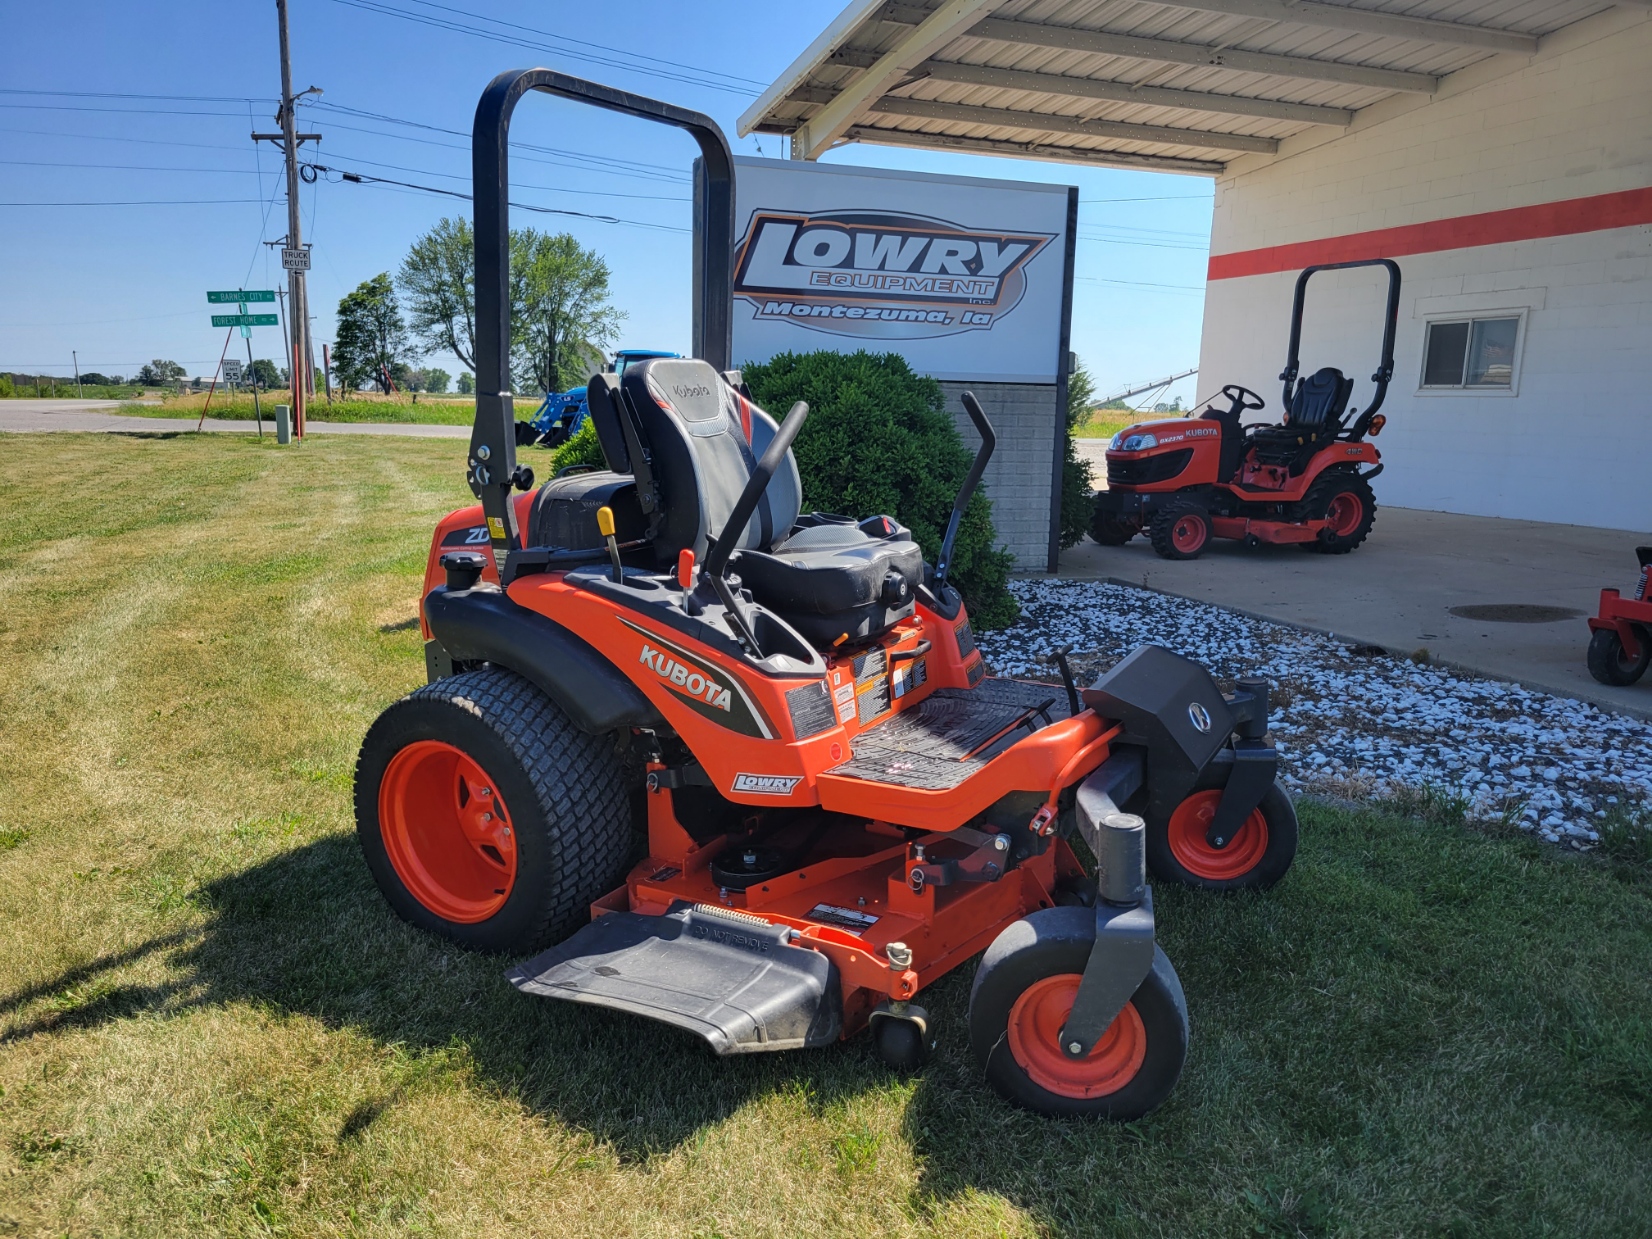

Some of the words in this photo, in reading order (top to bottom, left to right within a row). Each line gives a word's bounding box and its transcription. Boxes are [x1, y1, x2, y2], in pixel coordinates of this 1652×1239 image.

[284, 251, 308, 259] TRUCK
[742, 222, 1030, 288] LOWRY
[284, 259, 309, 267] ROUTE
[809, 270, 997, 296] EQUIPMENT
[220, 292, 246, 301] BARNES
[249, 292, 263, 301] CITY
[762, 300, 955, 326] Montezuma,
[213, 316, 236, 325] FOREST
[240, 316, 258, 325] HOME
[225, 372, 239, 380] 55
[672, 383, 710, 398] Kubota
[1185, 428, 1218, 437] KUBOTA
[465, 527, 490, 544] ZD
[639, 644, 732, 712] KUBOTA
[735, 775, 798, 789] LOWRY
[695, 925, 709, 935] DO
[713, 929, 732, 941] NOT
[731, 934, 770, 950] REMOVE
